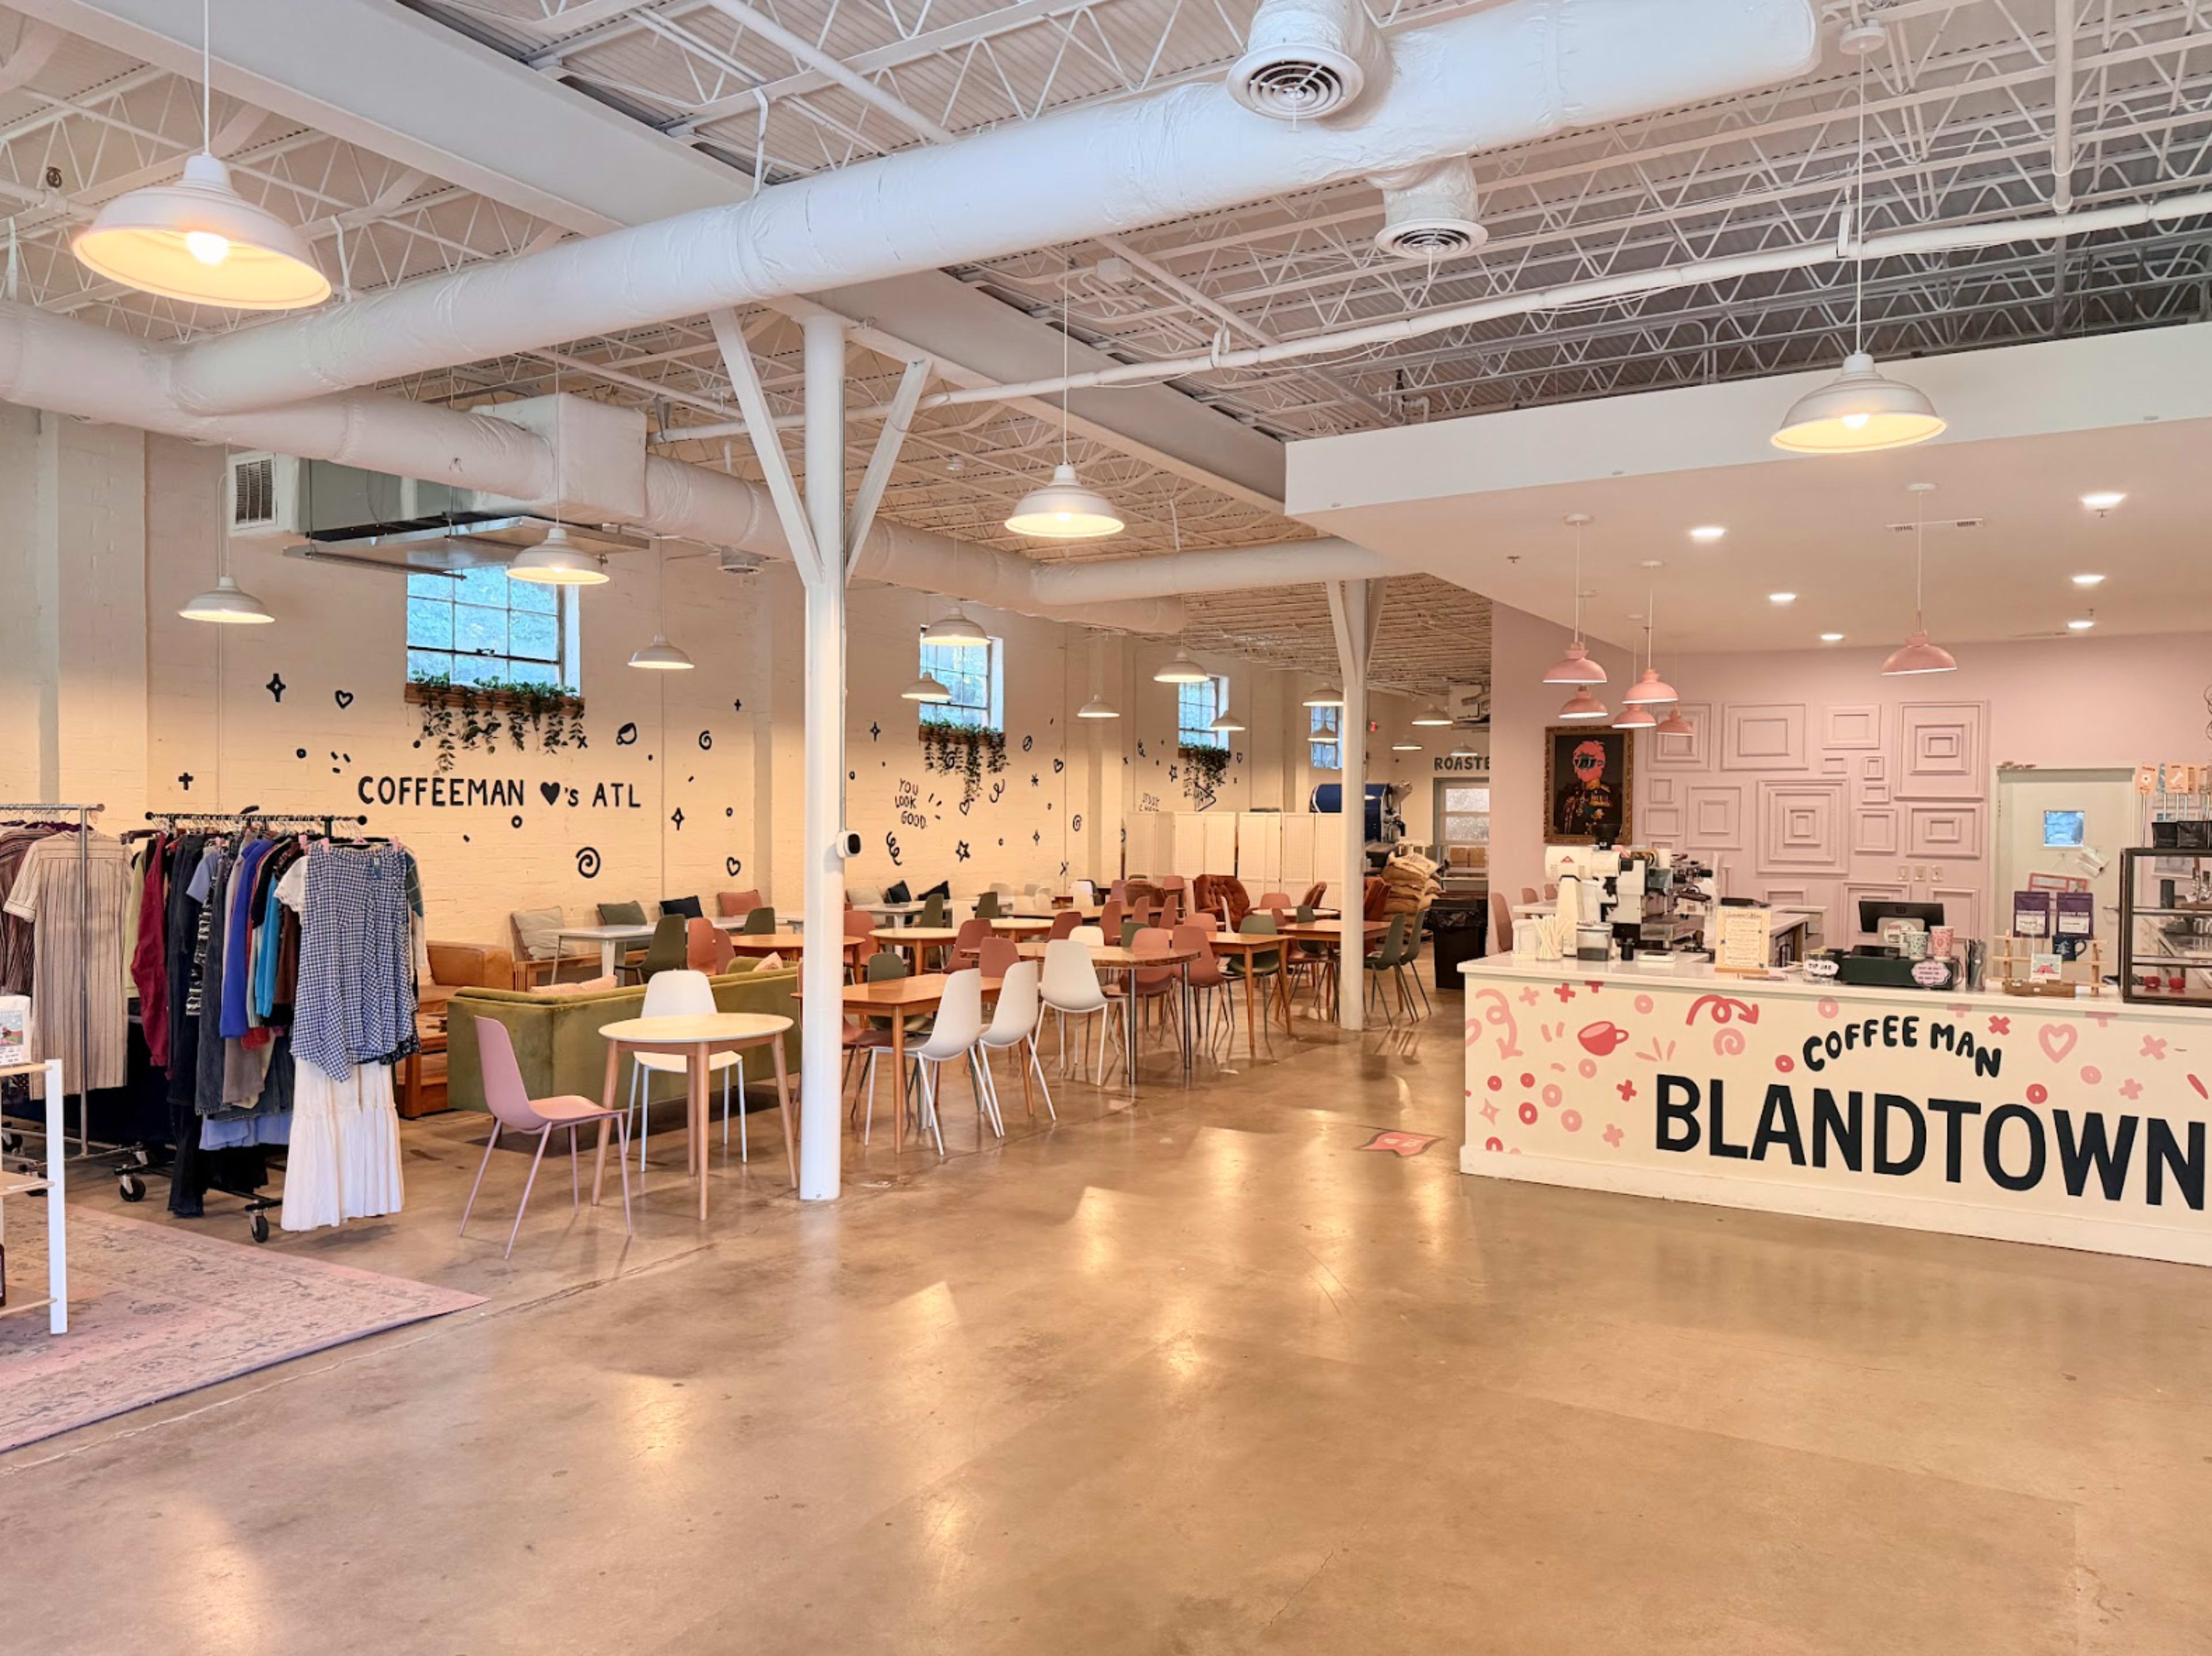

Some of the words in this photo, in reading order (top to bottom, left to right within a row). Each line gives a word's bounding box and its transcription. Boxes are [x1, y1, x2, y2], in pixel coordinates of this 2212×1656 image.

[1434, 756, 1490, 771] ROASTE
[358, 776, 524, 806] COFFEEMAN
[592, 783, 641, 808] ATL
[899, 778, 919, 795] YOU
[895, 795, 916, 809] LOOK
[1803, 1015, 1919, 1072] COFFEE
[1930, 1023, 2002, 1078] MAN
[1656, 1074, 2206, 1211] BLANDTOWN
